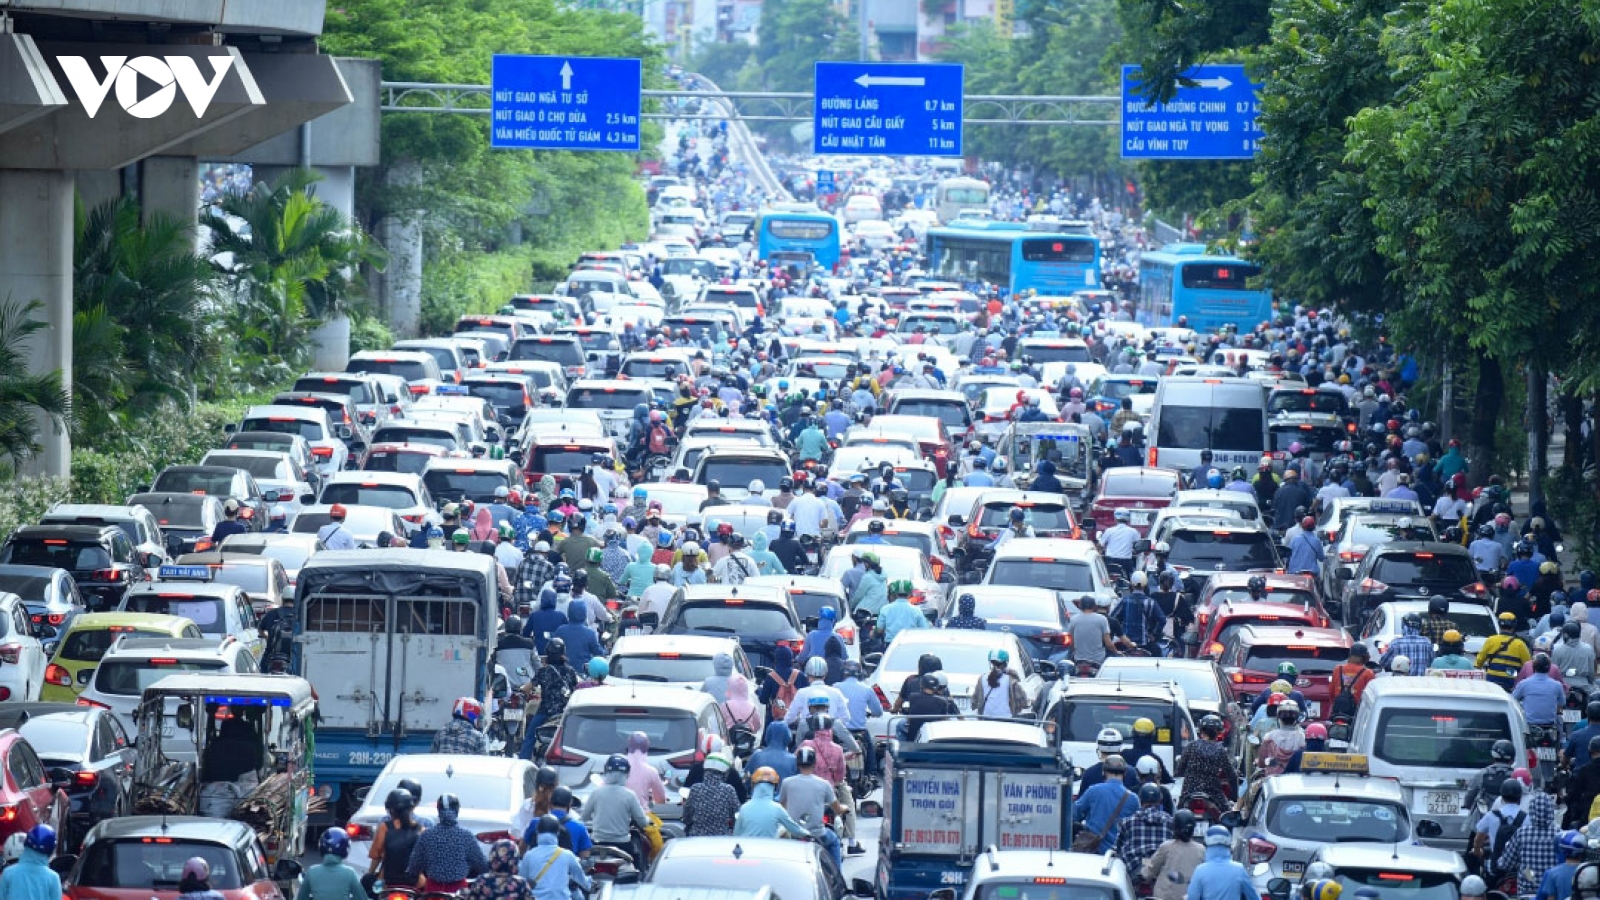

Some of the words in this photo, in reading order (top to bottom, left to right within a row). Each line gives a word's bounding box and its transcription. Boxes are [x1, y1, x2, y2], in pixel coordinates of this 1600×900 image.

[495, 88, 512, 102] NÚT
[515, 91, 536, 103] GIAO
[821, 95, 852, 110] ĐƯỜNG
[855, 95, 879, 110] LÁNG
[940, 100, 955, 111] km
[495, 107, 512, 121] NÚT
[515, 110, 536, 122] GIAO
[547, 111, 566, 124] CHỢ
[622, 113, 637, 125] km
[821, 114, 839, 129] NÚT
[841, 117, 862, 129] GIAO
[932, 119, 939, 130] 5
[940, 119, 955, 130] km
[1127, 117, 1144, 132] NÚT
[1147, 121, 1167, 132] GIAO
[1205, 121, 1229, 134] VỌNG
[1243, 121, 1250, 132] 3
[495, 126, 513, 140] VĂN
[578, 128, 600, 142] GIÁM
[621, 132, 637, 144] km
[841, 135, 865, 149] NHẬT
[928, 137, 938, 148] 11
[940, 138, 955, 148] km
[906, 775, 940, 795] CHUYỂN
[942, 780, 960, 796] NHÀ
[1004, 782, 1023, 799] VĂN
[1025, 783, 1057, 800] PHÒNG
[911, 798, 936, 809] TRỌN
[939, 798, 955, 810] GÓI
[1007, 803, 1033, 815] TRỌN
[1036, 803, 1052, 815] GÓI
